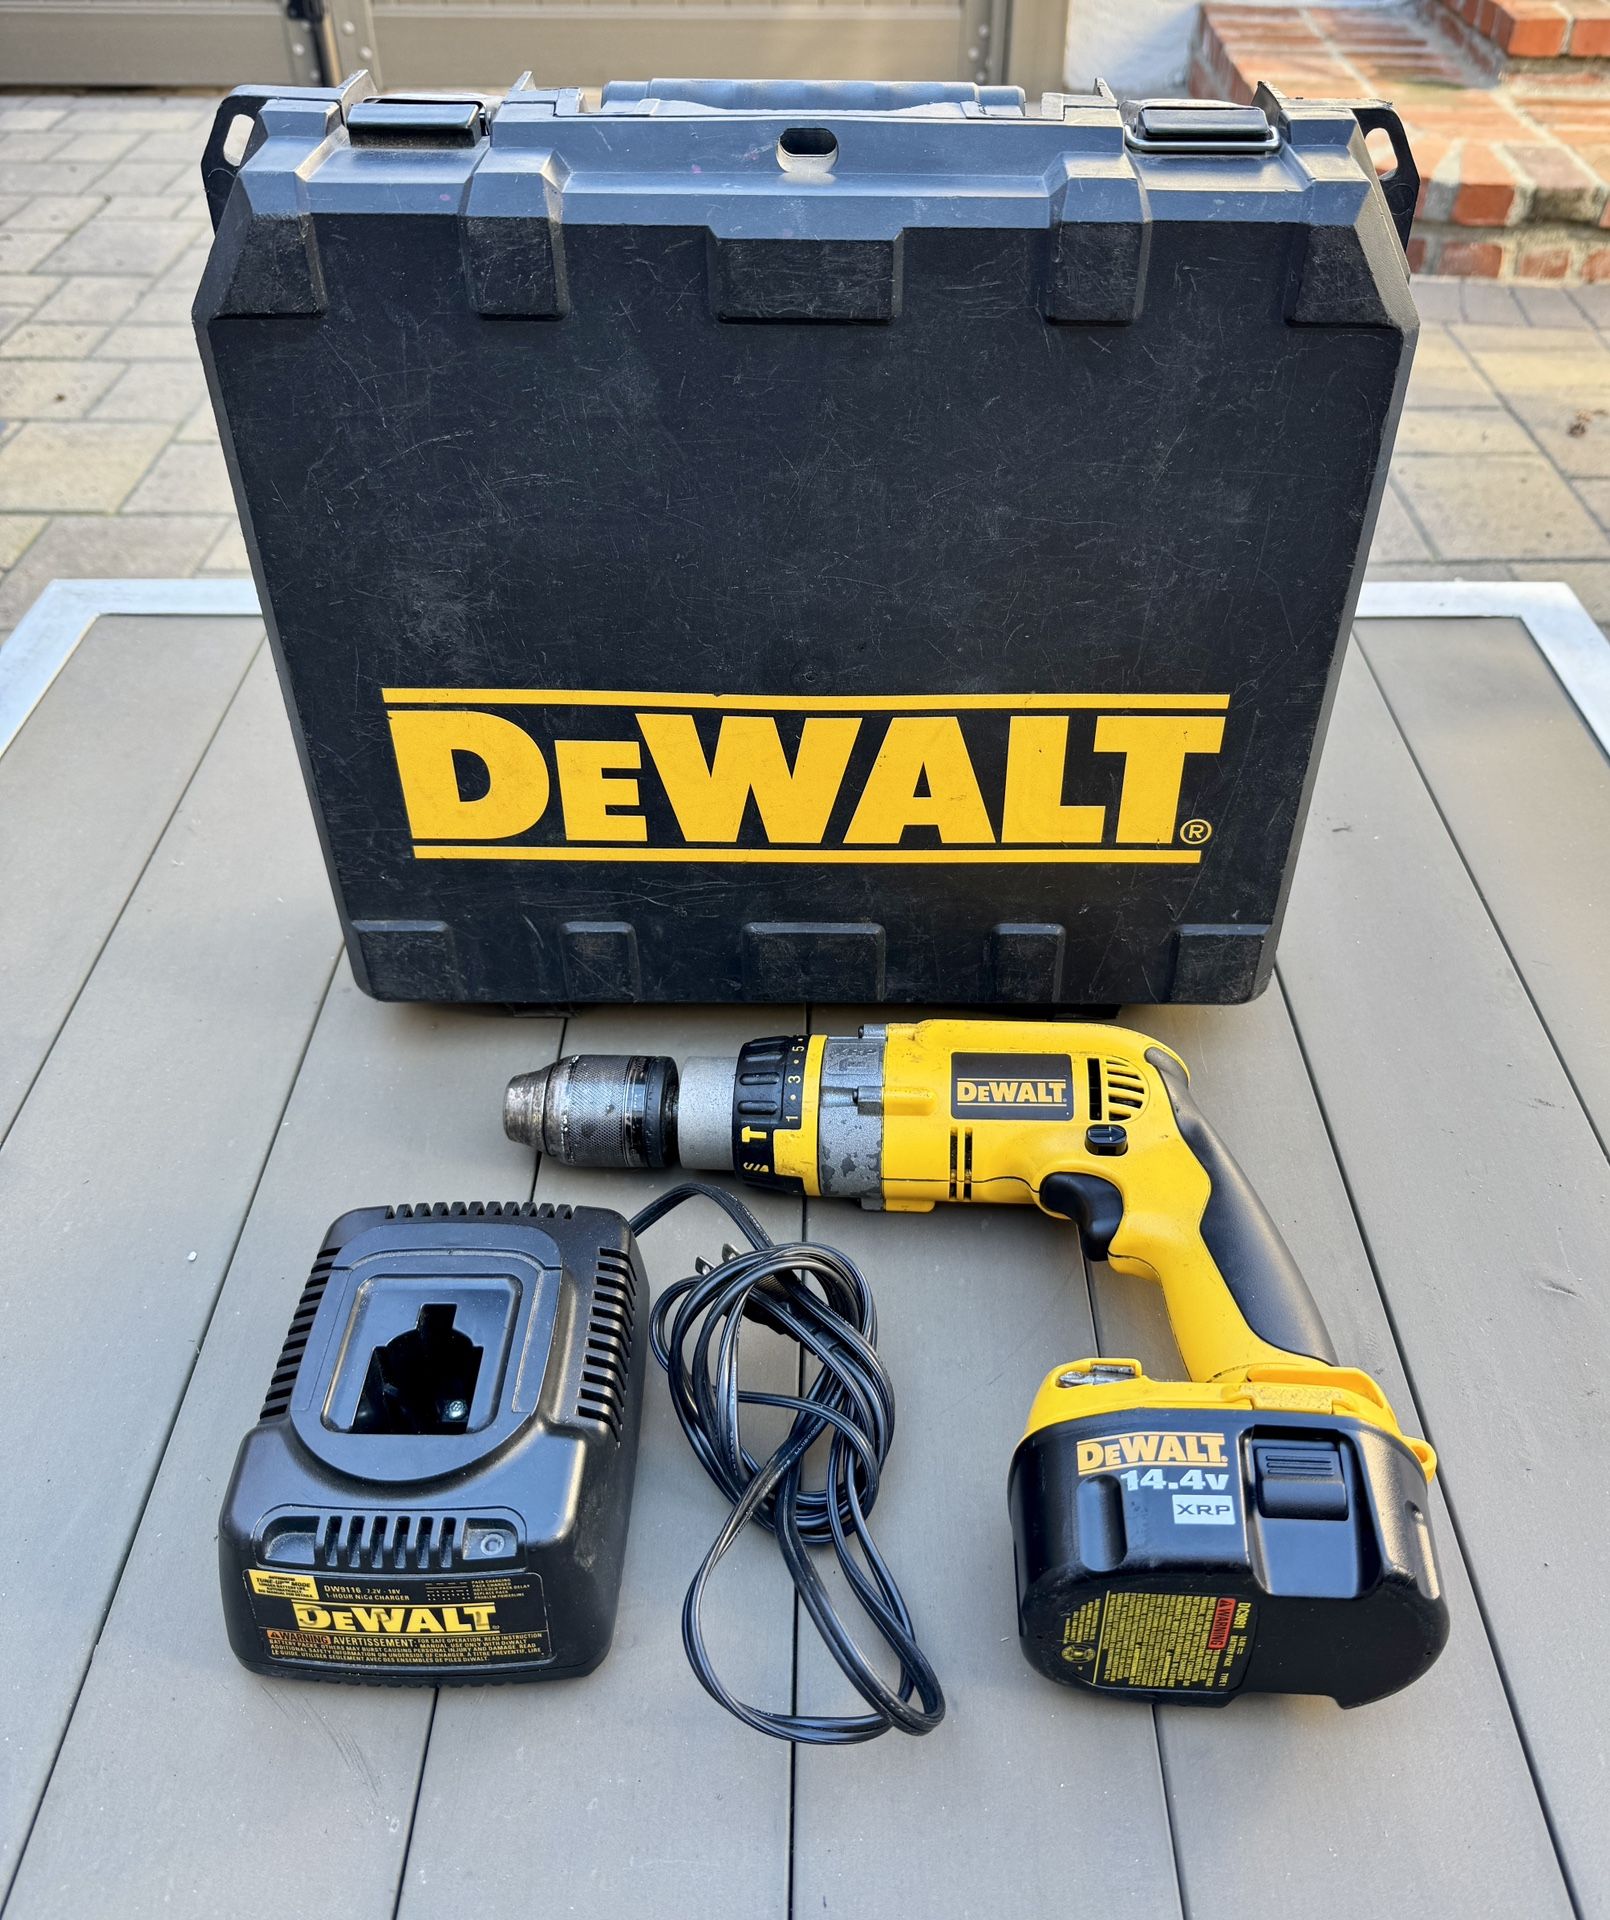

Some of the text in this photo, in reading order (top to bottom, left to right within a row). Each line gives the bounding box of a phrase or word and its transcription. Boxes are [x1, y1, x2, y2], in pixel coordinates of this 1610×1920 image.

[788, 1075, 801, 1084] 3
[956, 1082, 1067, 1102] DEWALT
[1175, 1504, 1230, 1516] XRP
[324, 1585, 361, 1593] DW9116
[1210, 1608, 1232, 1646] WARNING
[280, 1631, 329, 1644] WARNING
